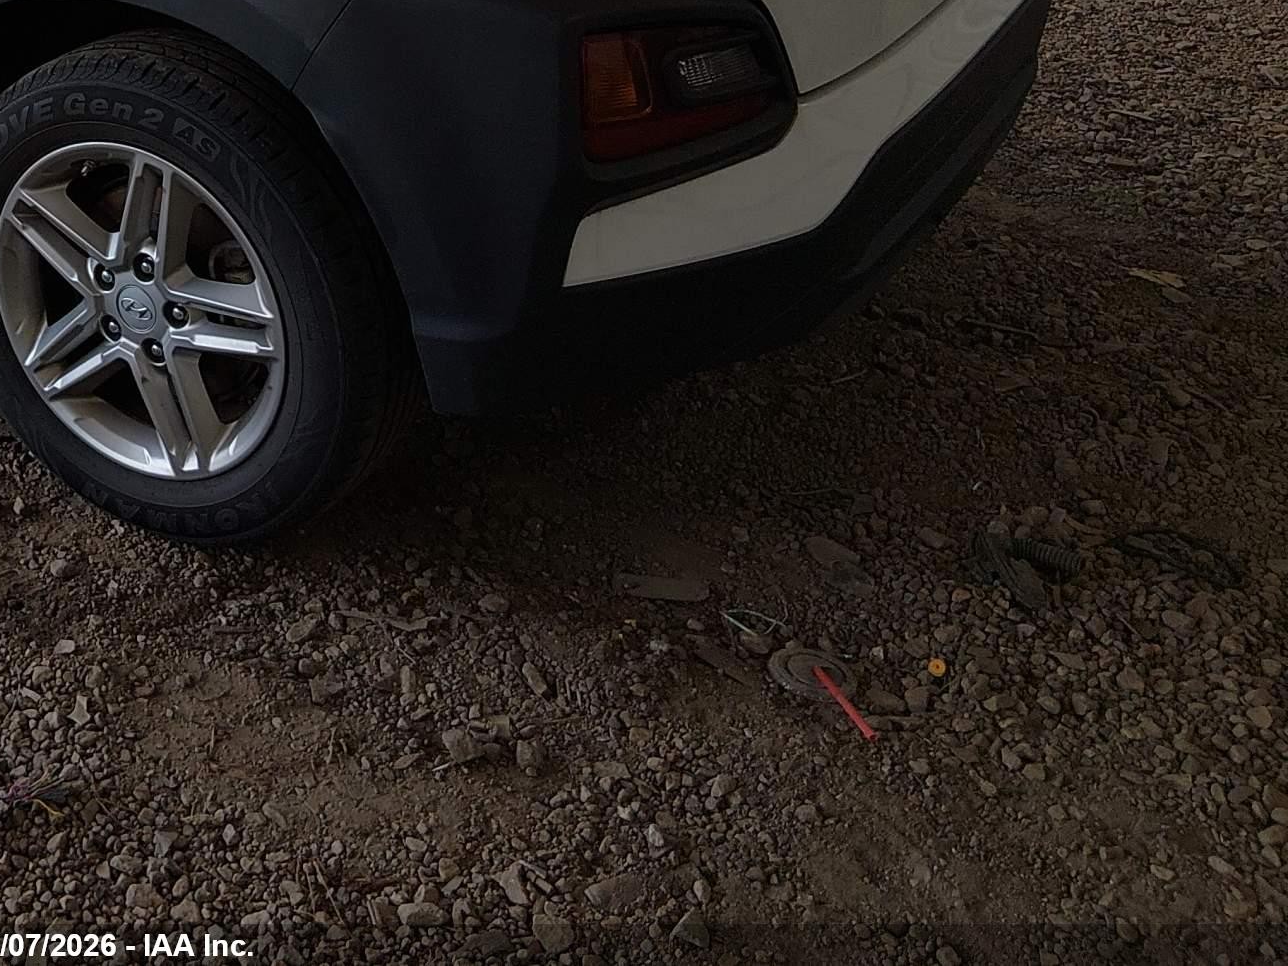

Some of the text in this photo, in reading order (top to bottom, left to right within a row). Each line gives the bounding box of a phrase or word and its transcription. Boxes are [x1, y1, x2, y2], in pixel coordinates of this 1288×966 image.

[63, 92, 133, 121] Gen
[141, 107, 165, 131] 2
[173, 119, 220, 160] AS
